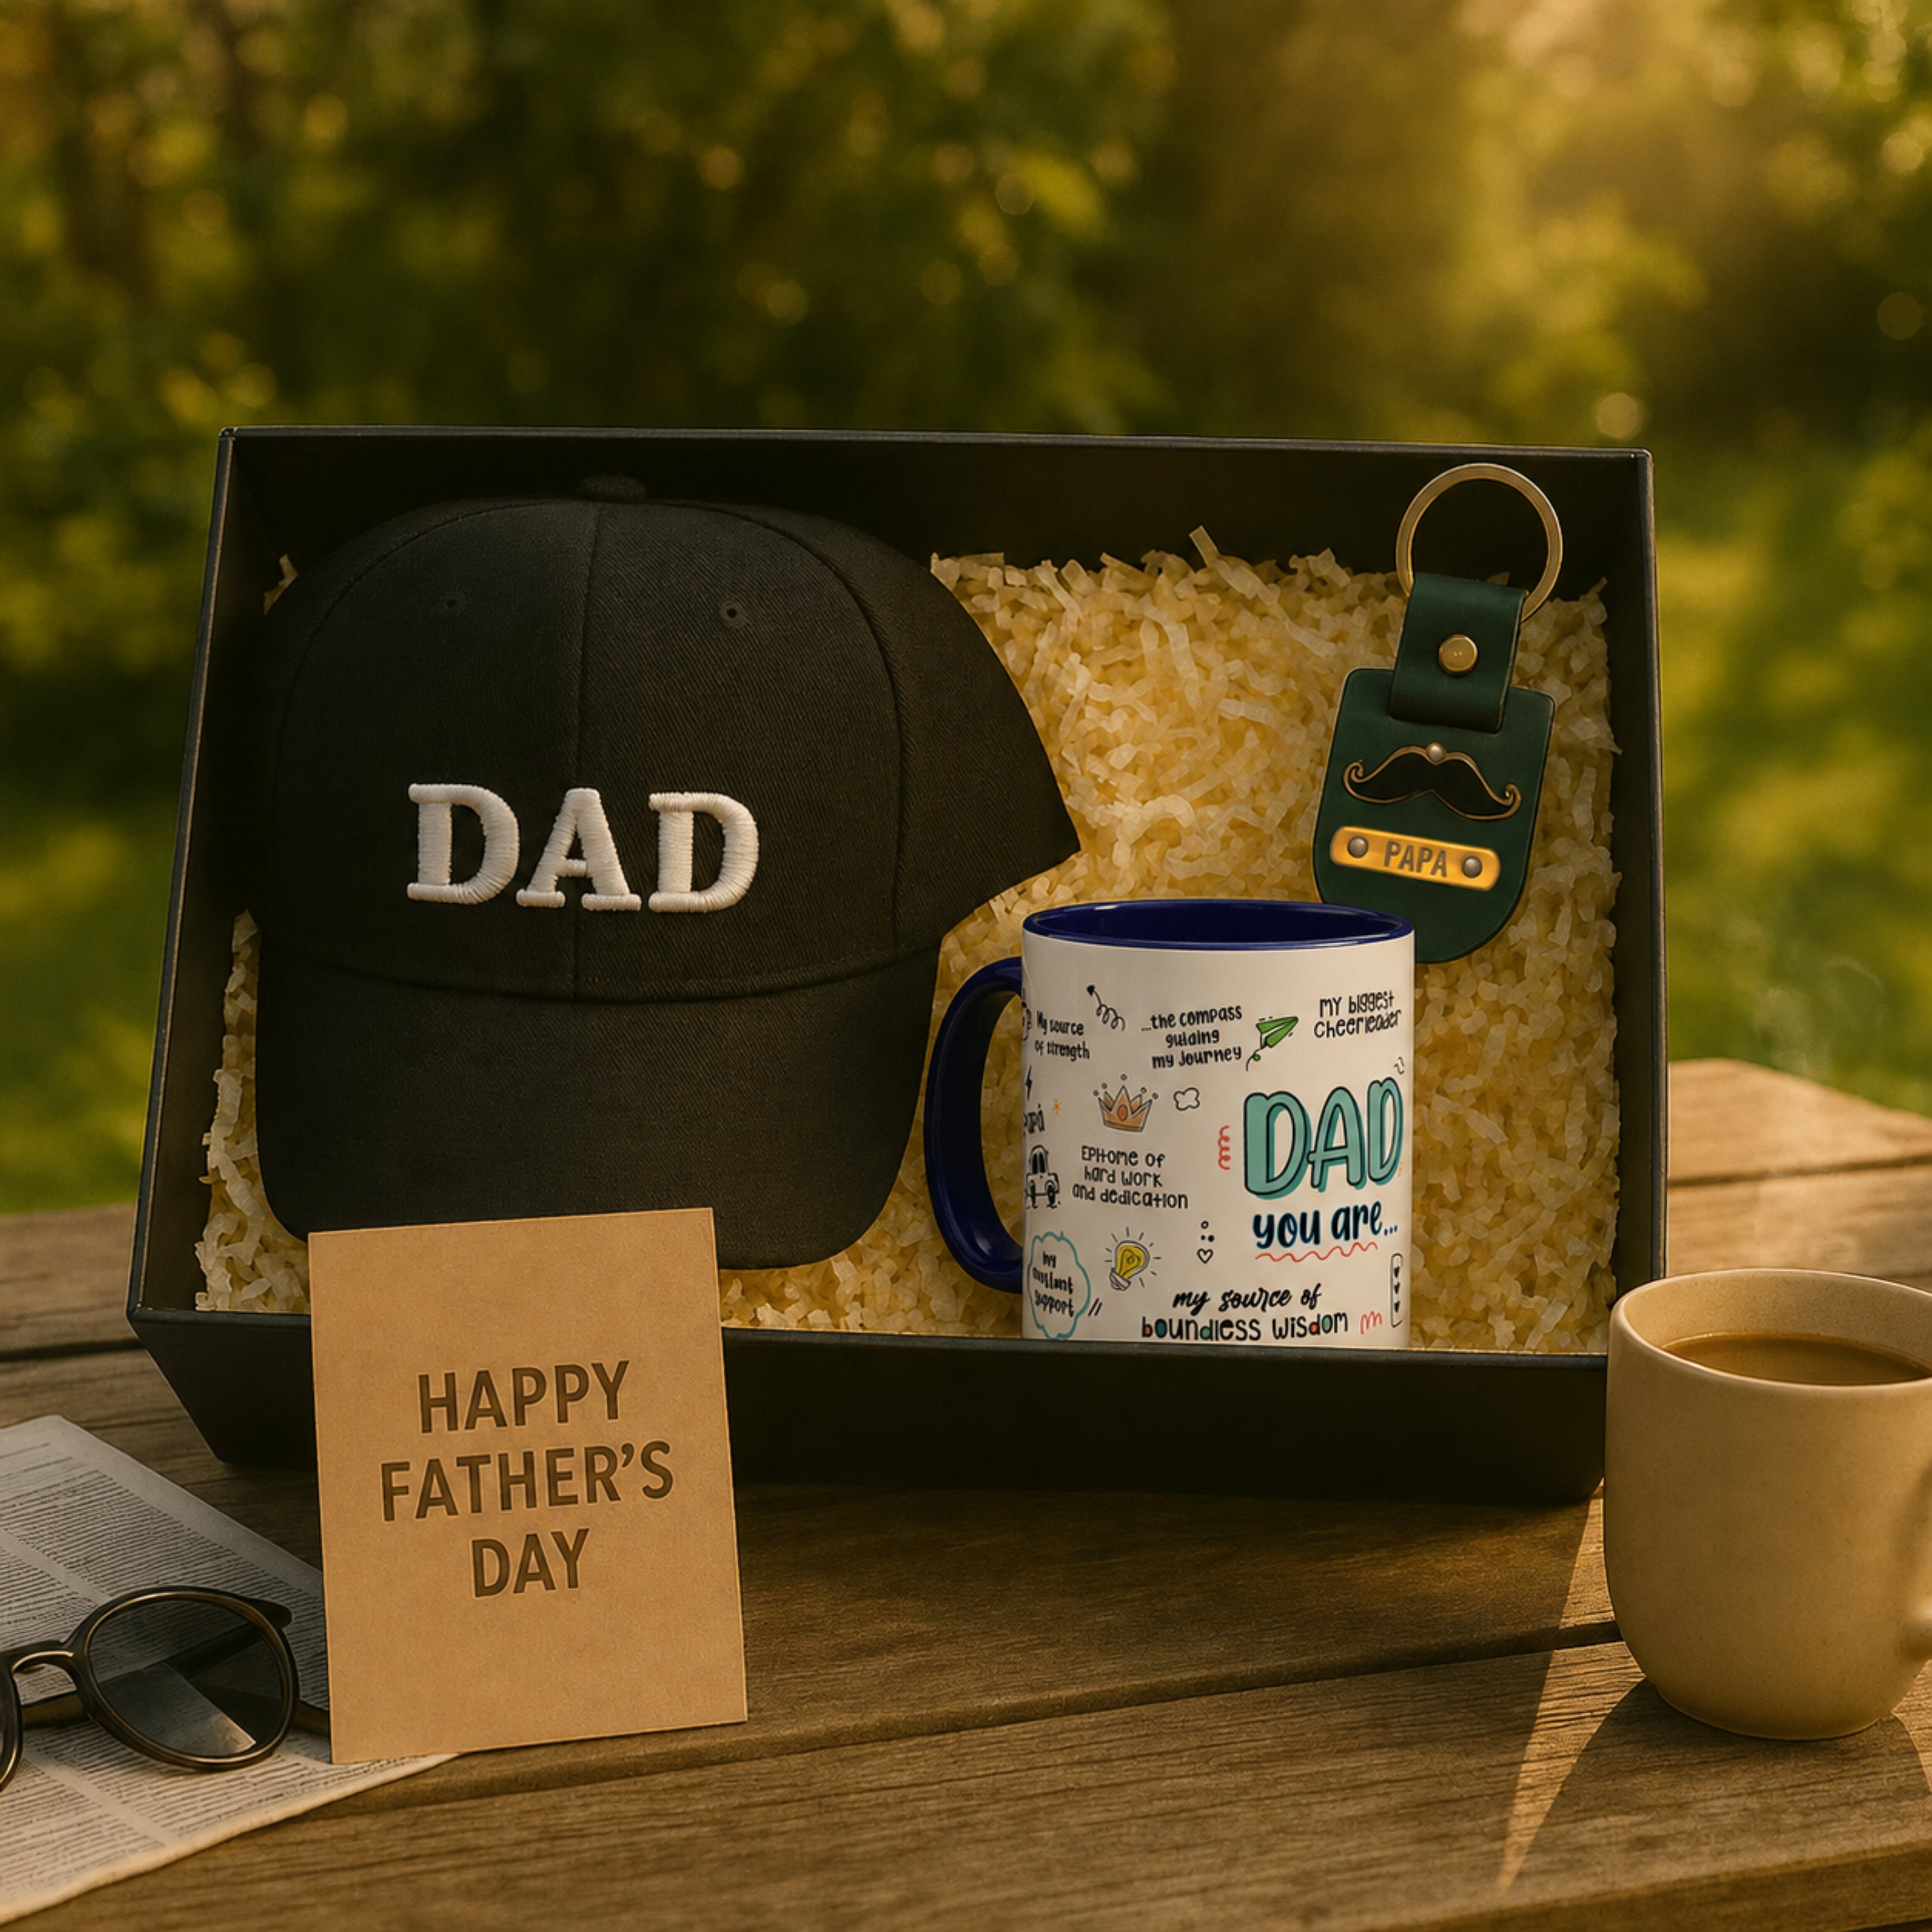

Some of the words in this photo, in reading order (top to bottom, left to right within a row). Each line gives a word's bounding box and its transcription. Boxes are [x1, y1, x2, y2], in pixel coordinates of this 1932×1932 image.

[407, 783, 759, 912] DAD
[1384, 840, 1447, 877] PAPA
[1179, 1005, 1242, 1026] compass
[1349, 990, 1394, 1014] biggest
[1050, 1020, 1084, 1036] source
[1152, 1054, 1174, 1069] my
[1243, 1077, 1404, 1200] DAD
[1145, 1153, 1165, 1168] of
[1084, 1165, 1116, 1183] hard
[1121, 1171, 1163, 1188] work
[1072, 1184, 1095, 1200] and
[1100, 1188, 1188, 1208] dedication
[1253, 1210, 1321, 1249] you
[1331, 1201, 1398, 1241] are...
[1172, 1290, 1210, 1316] my
[1218, 1287, 1293, 1312] source
[1300, 1283, 1322, 1310] of
[1141, 1316, 1261, 1341] boundless
[1272, 1312, 1348, 1340] wisdom
[418, 1360, 629, 1433] HAPPY
[381, 1440, 673, 1521] FATHER’S
[472, 1528, 589, 1598] DAY
